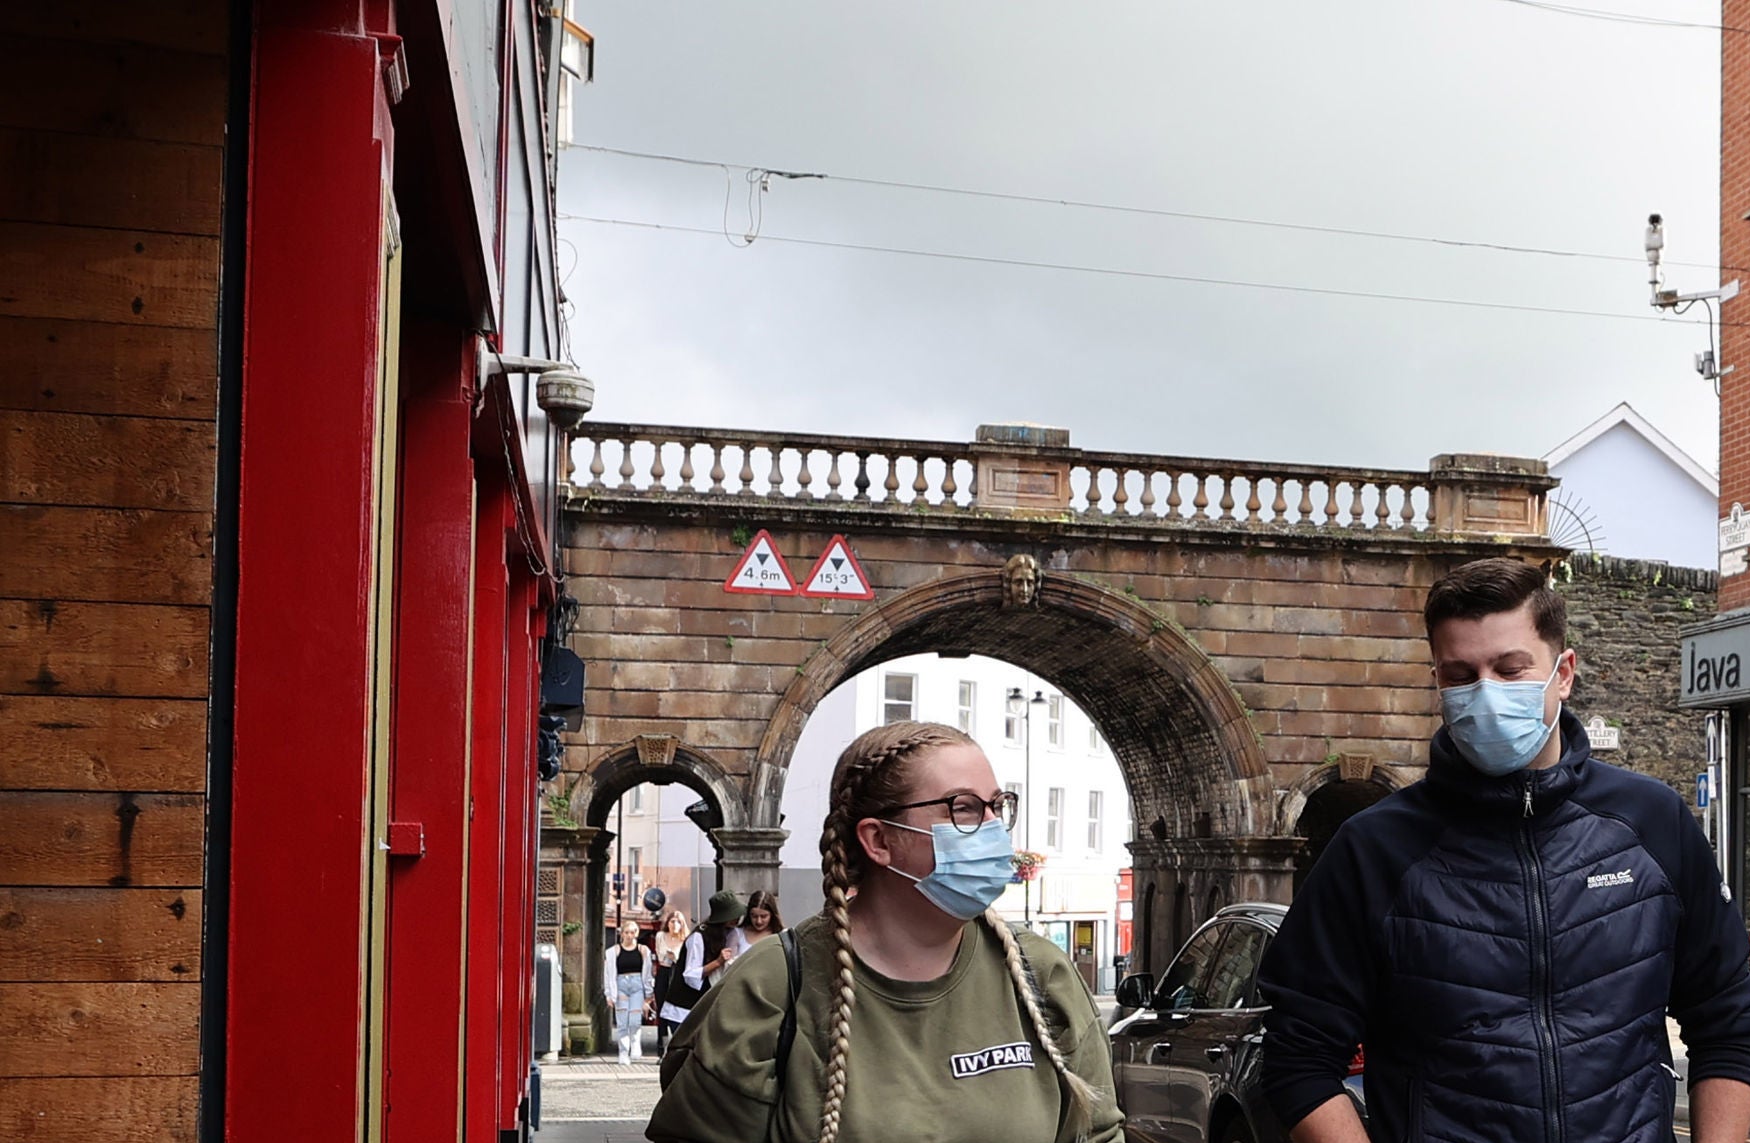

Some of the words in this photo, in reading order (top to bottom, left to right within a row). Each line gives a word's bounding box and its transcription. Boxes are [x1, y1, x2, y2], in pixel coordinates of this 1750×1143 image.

[1726, 532, 1745, 545] STREET
[744, 567, 780, 581] 4.6m
[959, 1051, 990, 1072] IVY
[991, 1046, 1033, 1064] PARK
